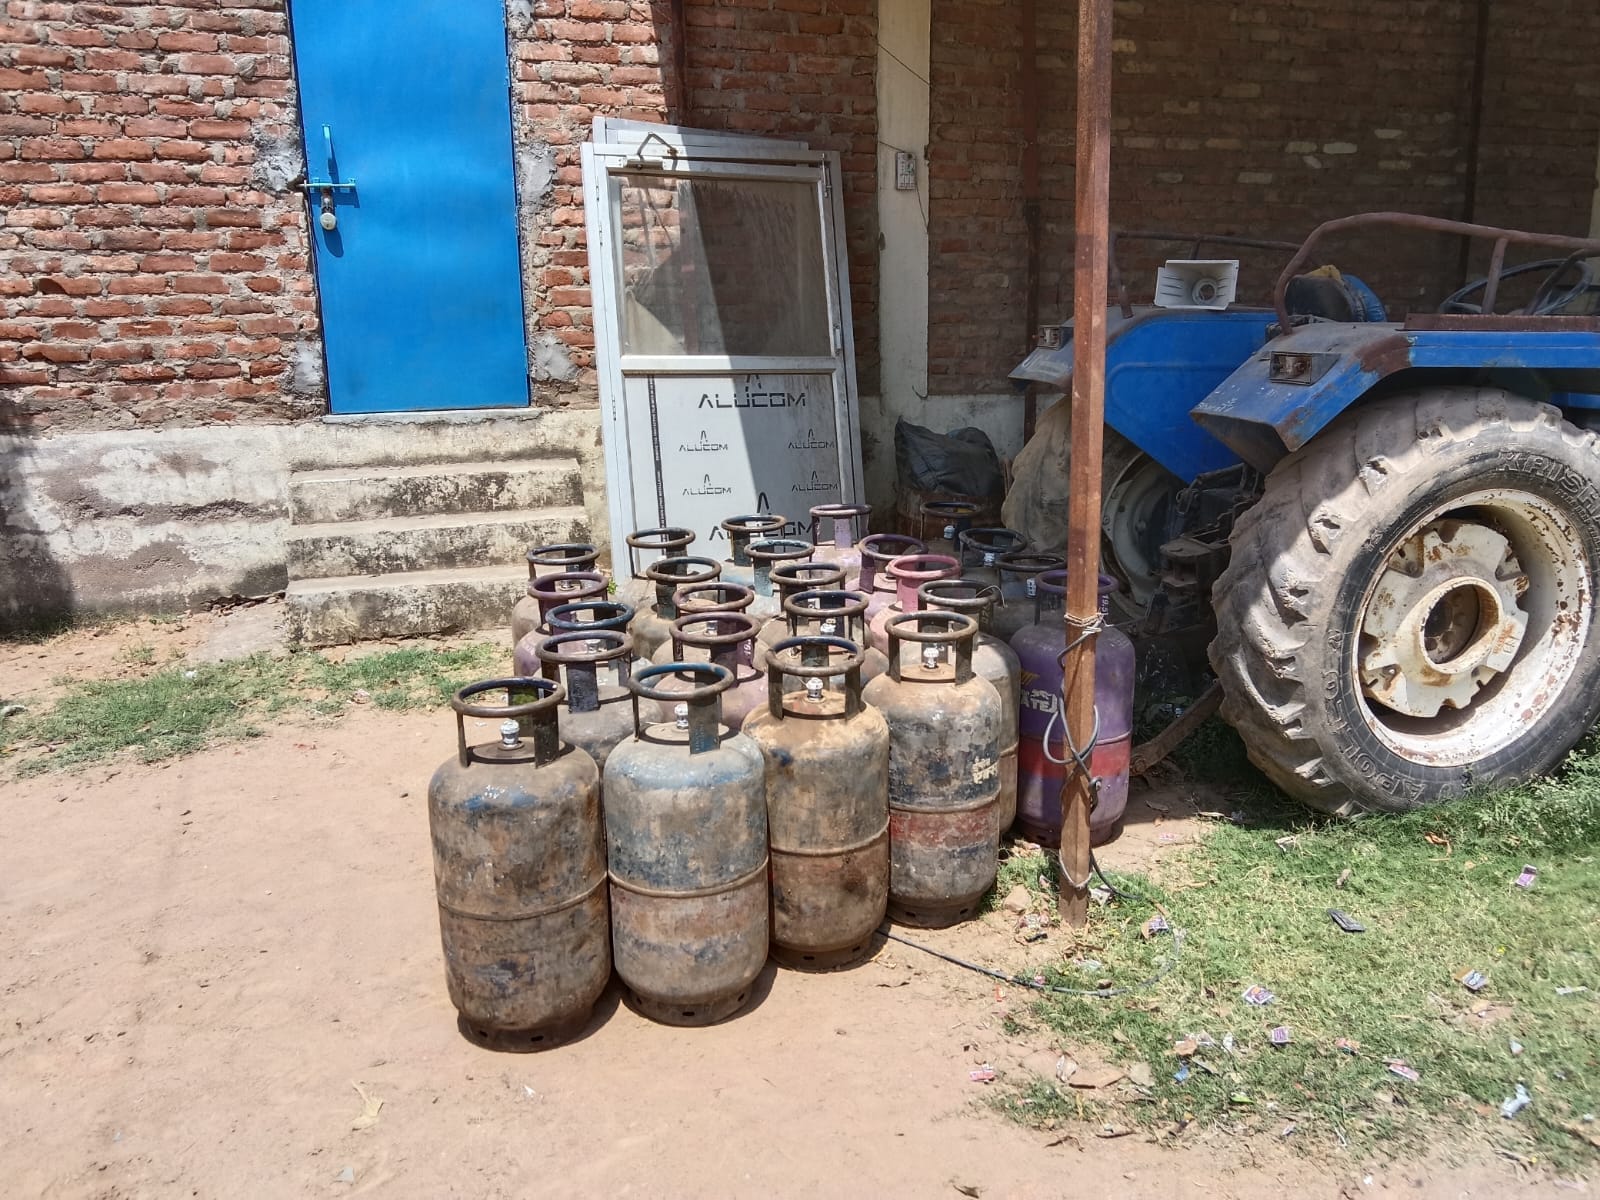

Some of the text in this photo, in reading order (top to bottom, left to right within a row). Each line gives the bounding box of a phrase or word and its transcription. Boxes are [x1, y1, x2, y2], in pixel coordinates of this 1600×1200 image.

[698, 392, 806, 409] ALUCOM
[678, 443, 729, 452] ALUCOM
[787, 441, 836, 450] ALUCOM
[682, 487, 732, 496] ALUCOM
[791, 483, 839, 492] ALUCOM
[1496, 450, 1600, 527] KRISH
